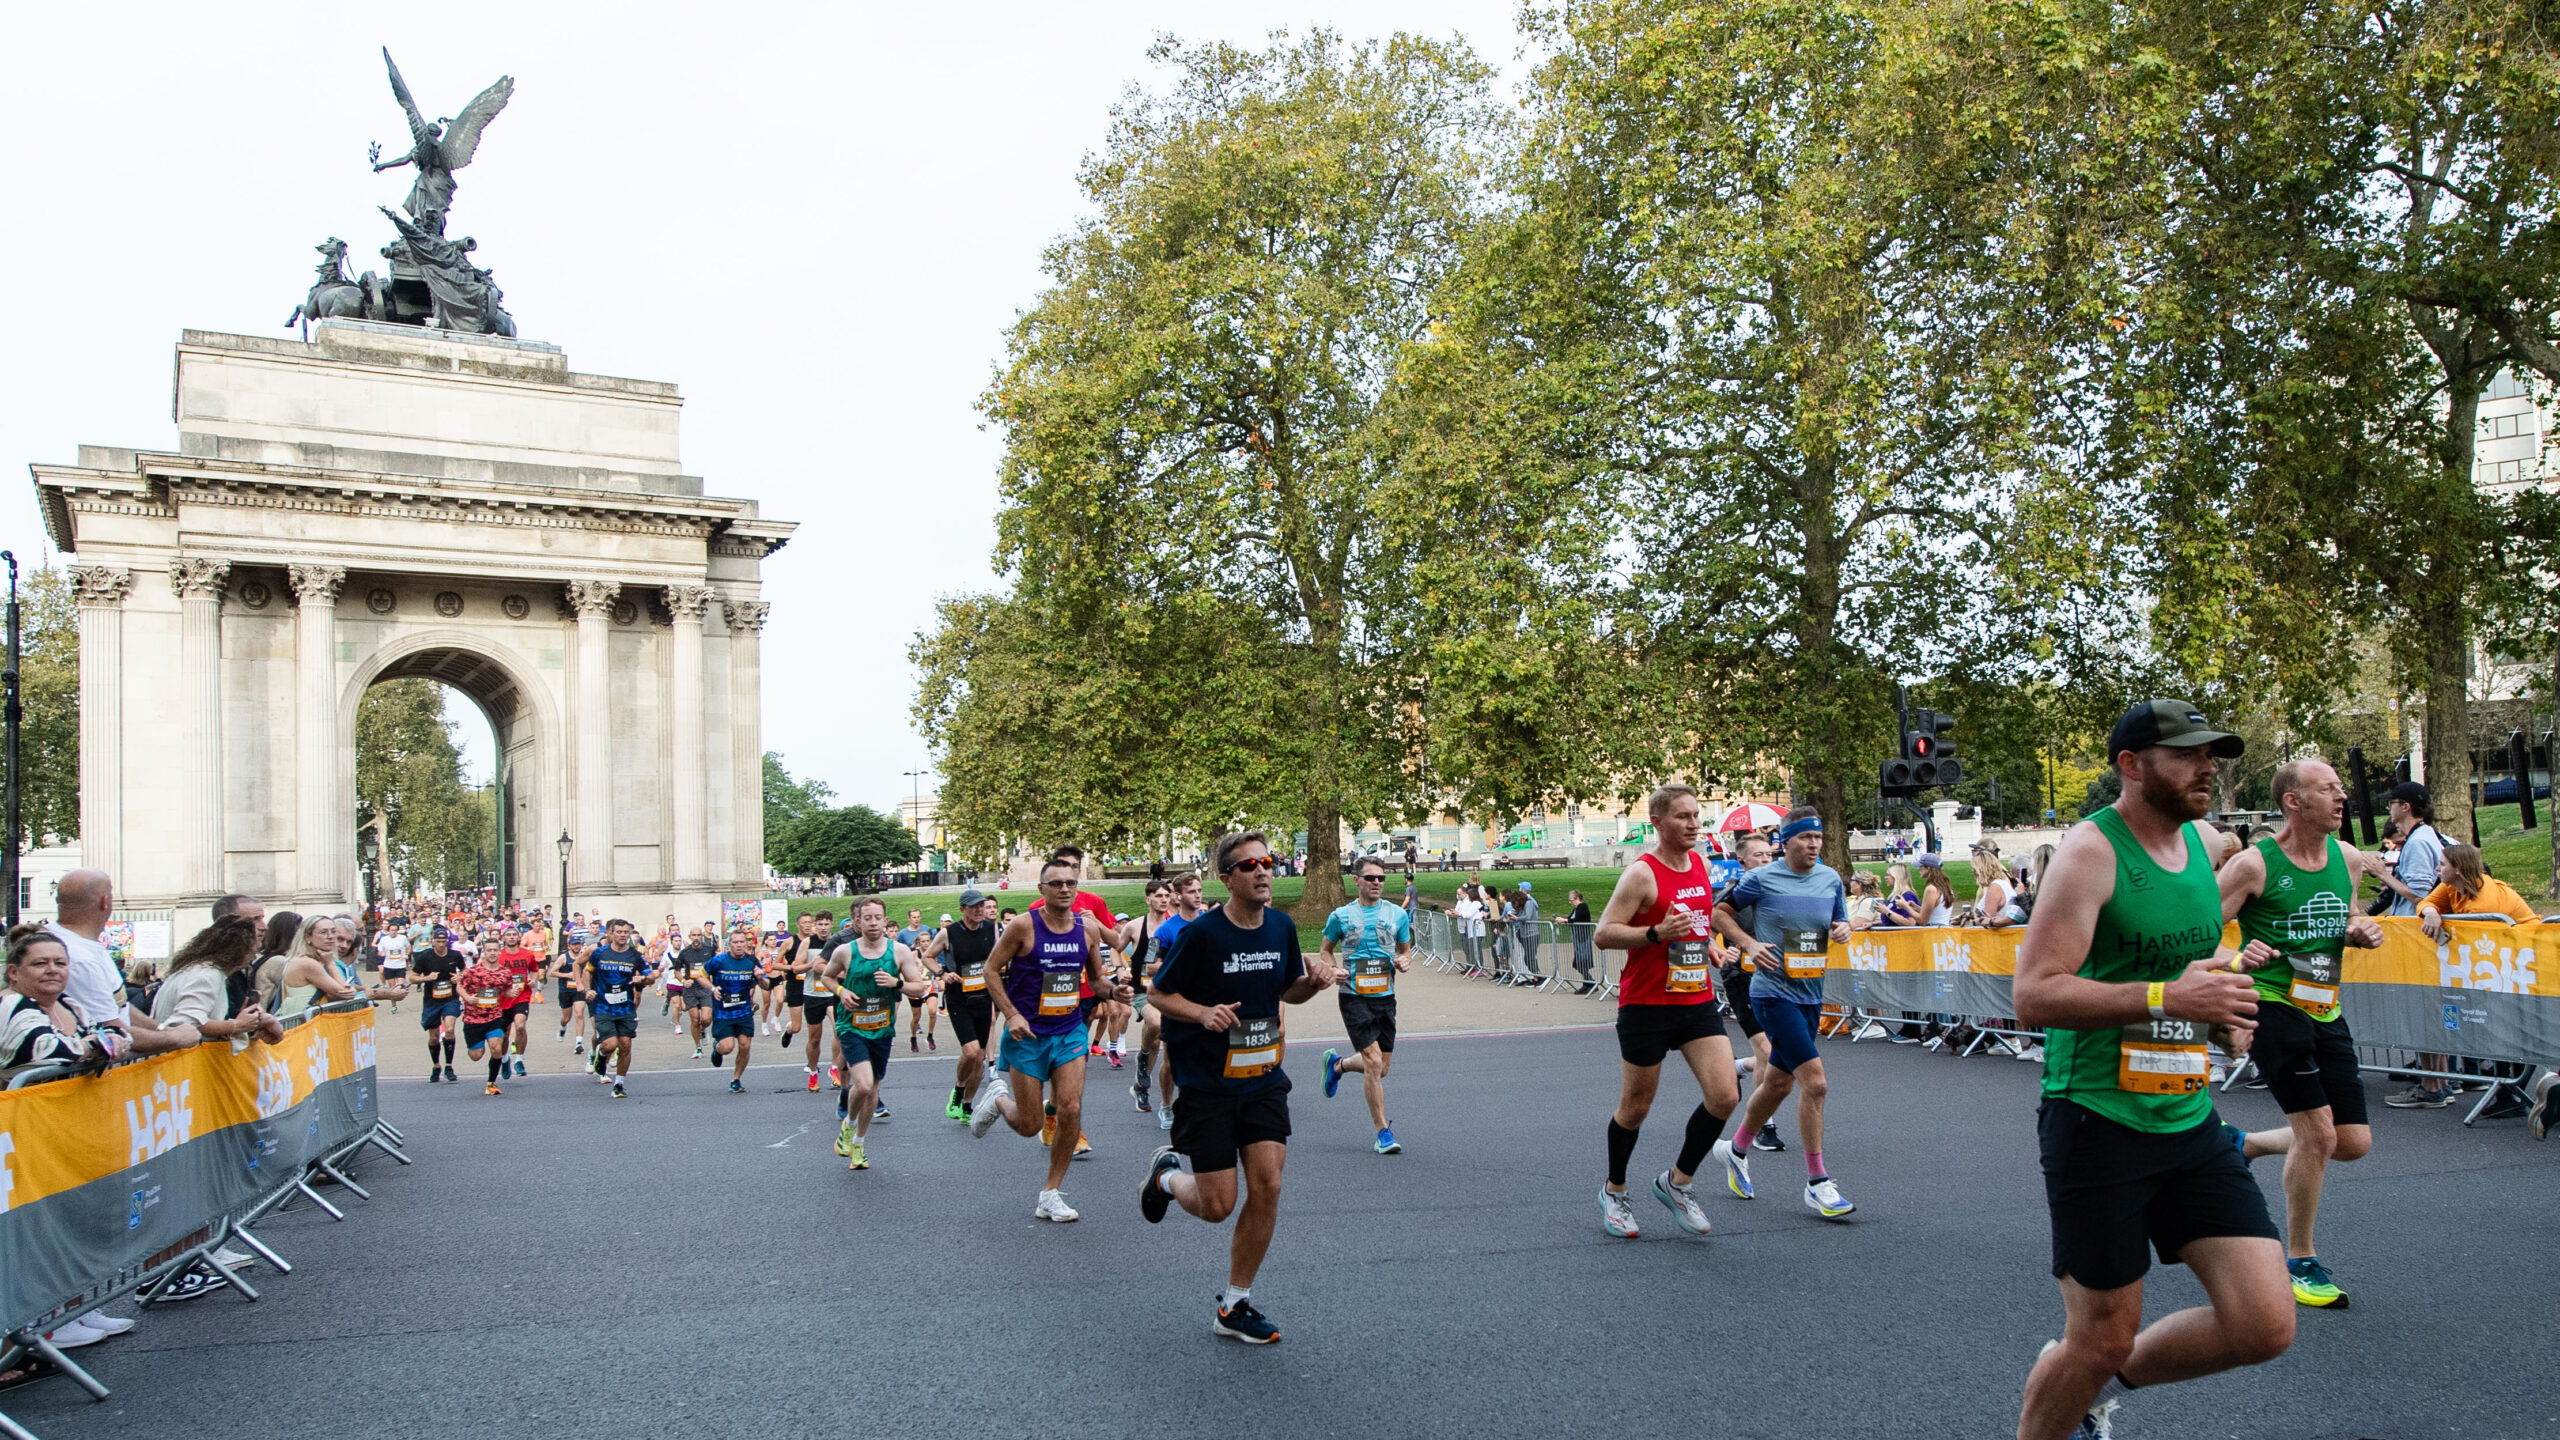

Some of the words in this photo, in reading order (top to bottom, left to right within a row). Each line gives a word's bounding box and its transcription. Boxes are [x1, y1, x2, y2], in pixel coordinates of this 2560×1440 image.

[1676, 886, 1706, 899] JAKUB
[2308, 917, 2348, 929] ROGUE
[2117, 925, 2214, 953] HARWELL
[2288, 928, 2345, 940] RUNNERS
[1044, 943, 1079, 953] DAMIAN
[1800, 943, 1818, 952] 874
[1240, 951, 1281, 963] Canterbury
[1682, 954, 1703, 965] 1323
[1848, 944, 1888, 973] Half
[1933, 942, 1971, 973] Half
[1240, 961, 1274, 972] Harriers
[2437, 944, 2536, 994] Half
[2312, 969, 2331, 982] 921
[1052, 983, 1074, 993] 1600
[2149, 1020, 2195, 1040] 1526
[1244, 1033, 1271, 1047] 1836
[126, 1079, 193, 1167] Half
